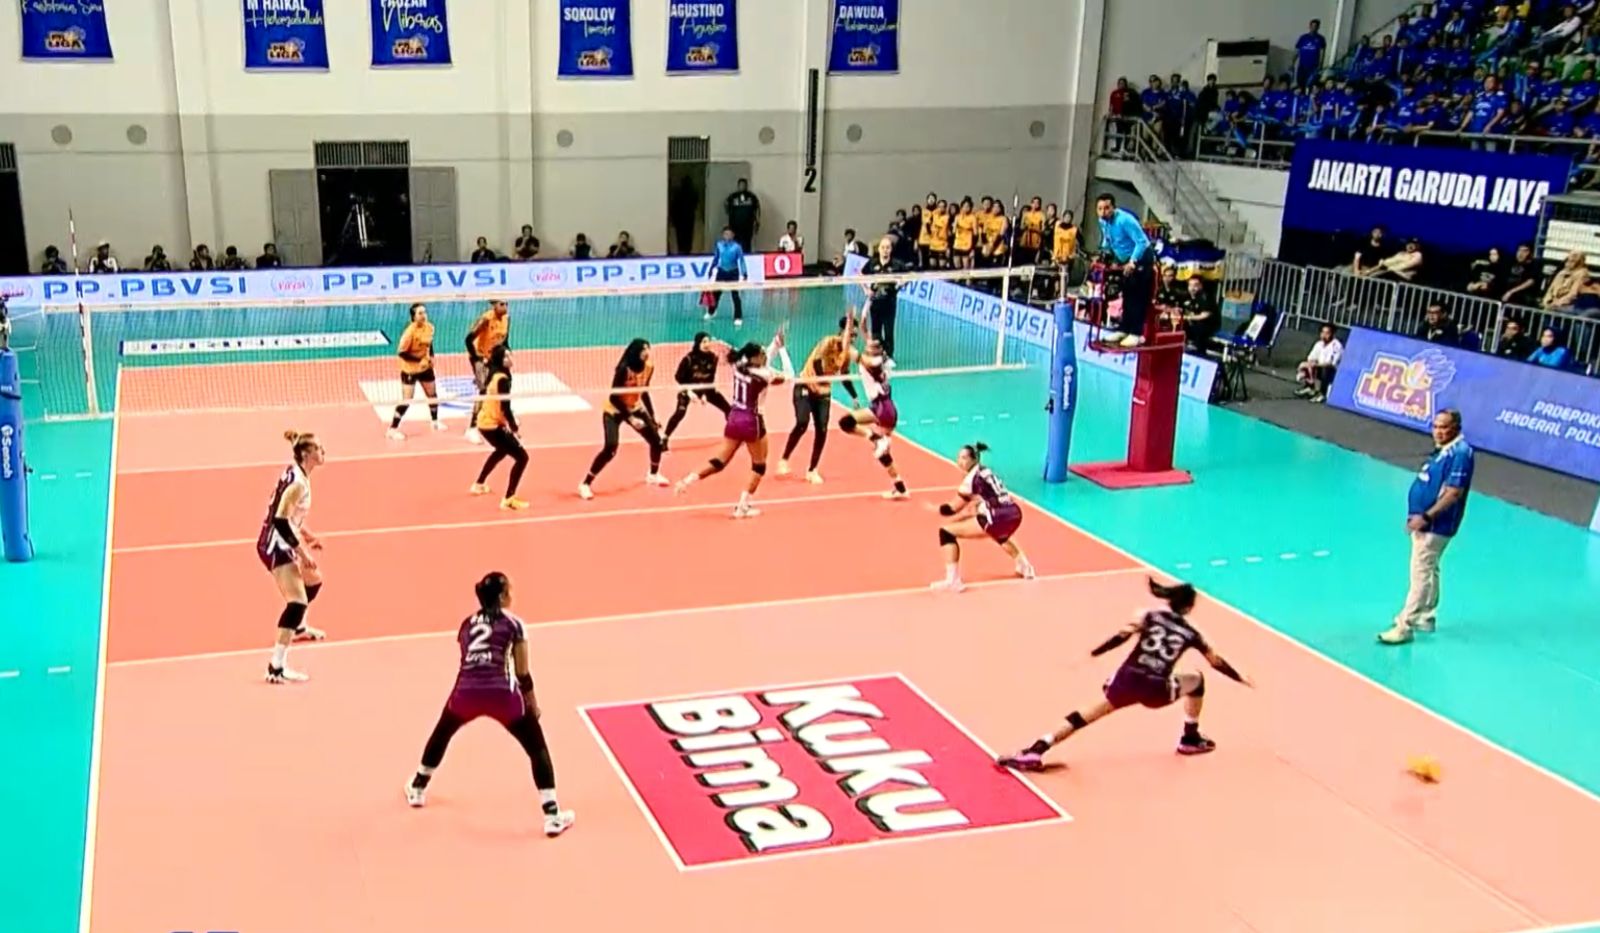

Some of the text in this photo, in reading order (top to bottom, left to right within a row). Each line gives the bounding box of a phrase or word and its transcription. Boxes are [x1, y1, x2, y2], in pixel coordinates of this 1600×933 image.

[671, 3, 725, 18] AGUSTINO
[839, 5, 885, 19] DAWUDA
[803, 167, 817, 193] 2
[1308, 158, 1550, 217] JAKARTA GARUDA JAYA
[576, 260, 710, 283] PP.PBV
[773, 254, 791, 275] 0
[43, 276, 247, 300] PP.PBVSI
[322, 267, 507, 291] PP.PBVSI
[1360, 377, 1428, 412] LIGA
[1496, 408, 1562, 437] JENDERAL
[1533, 400, 1600, 430] PADEPOK
[467, 622, 494, 652] 2
[760, 683, 972, 834] Kuku
[644, 692, 835, 854] Bima
